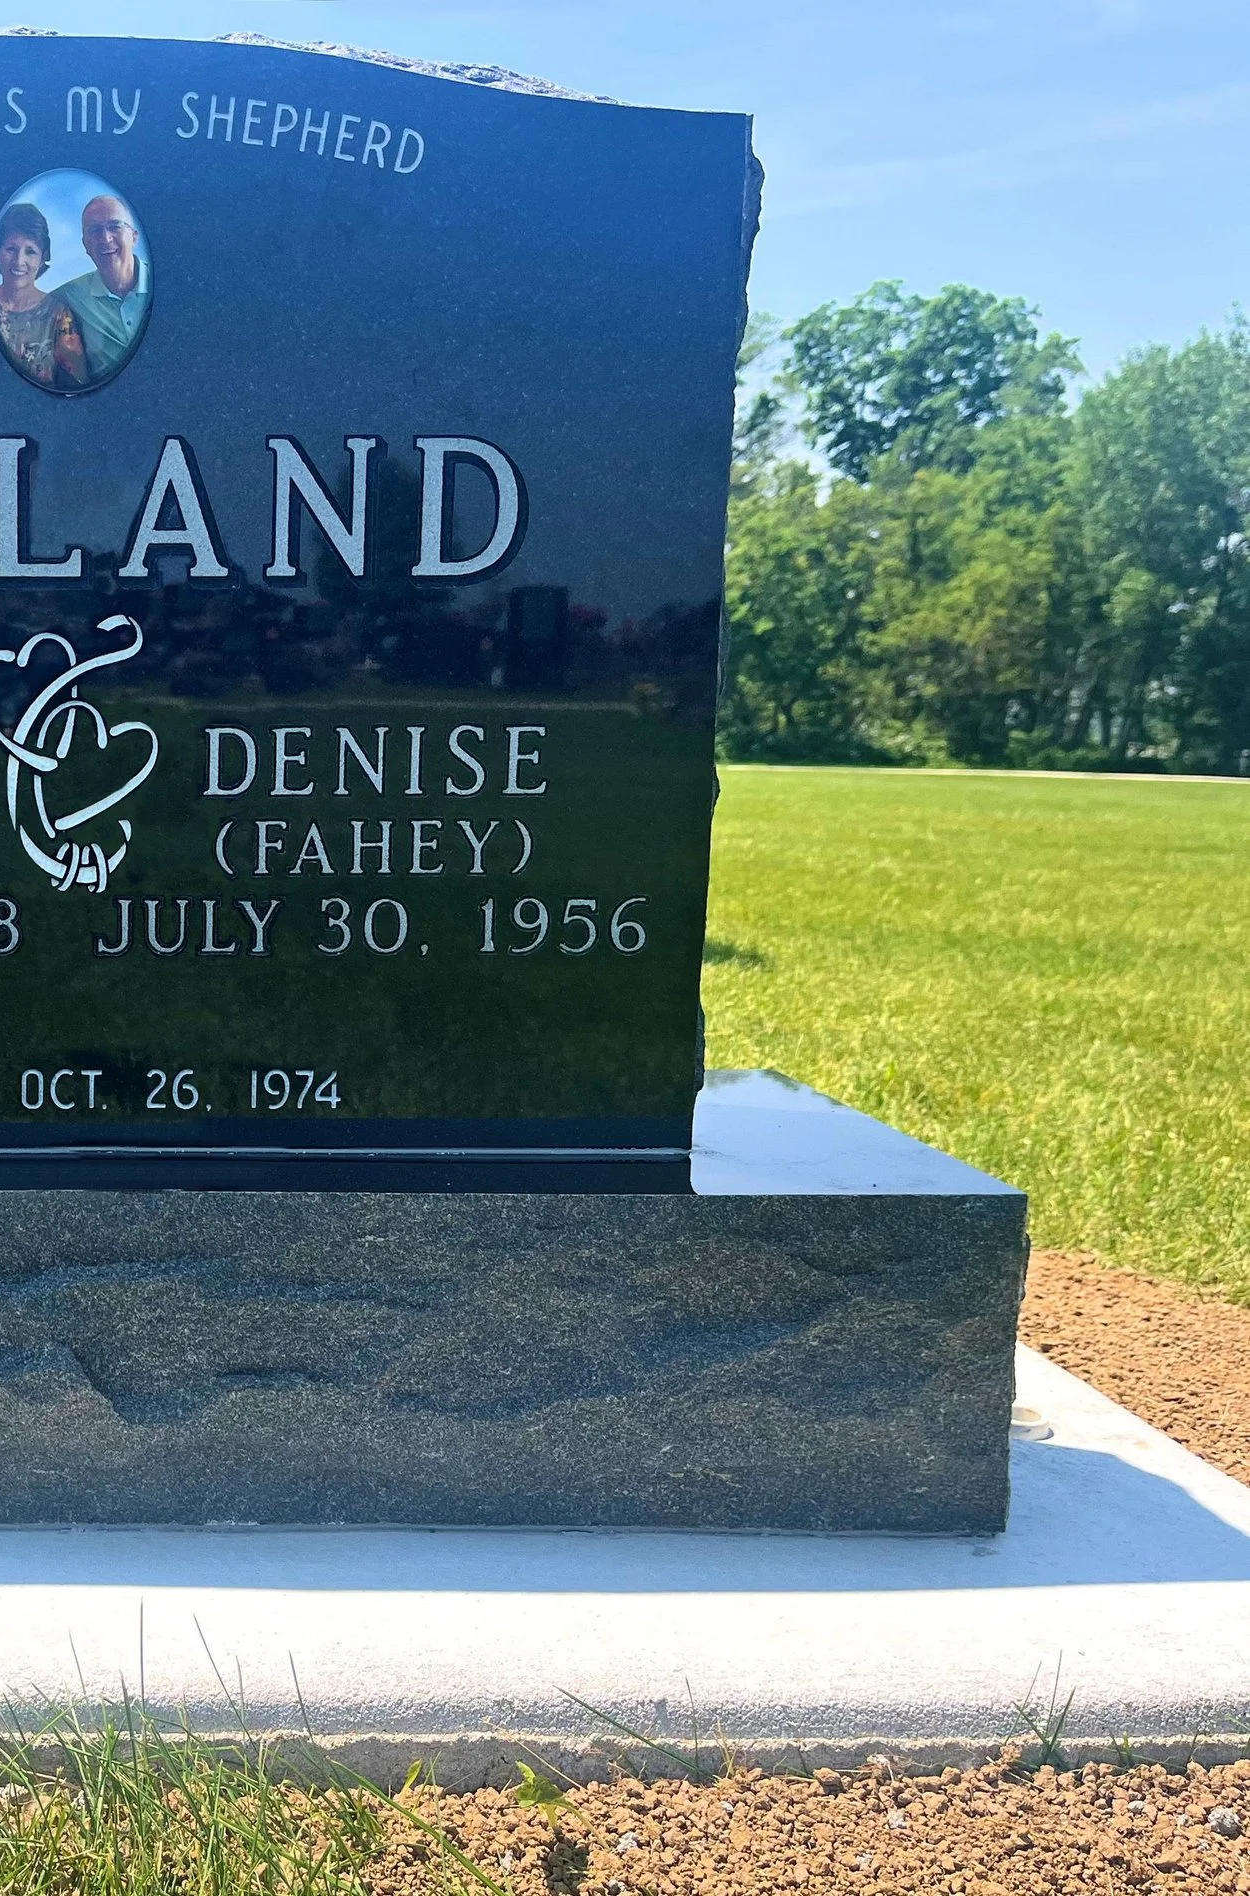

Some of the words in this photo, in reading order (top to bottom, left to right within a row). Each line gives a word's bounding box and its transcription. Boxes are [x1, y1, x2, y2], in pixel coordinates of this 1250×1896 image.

[66, 85, 142, 135] MY
[175, 91, 426, 175] SHEPHERD
[202, 725, 548, 797] DENISE
[214, 818, 533, 876] (FAHEY)
[96, 897, 282, 955] JULY
[317, 897, 430, 957] 30,
[479, 896, 649, 954] 1956
[20, 1069, 108, 1110] OCT.
[145, 1068, 213, 1113] 26,
[250, 1069, 343, 1110] 1974
